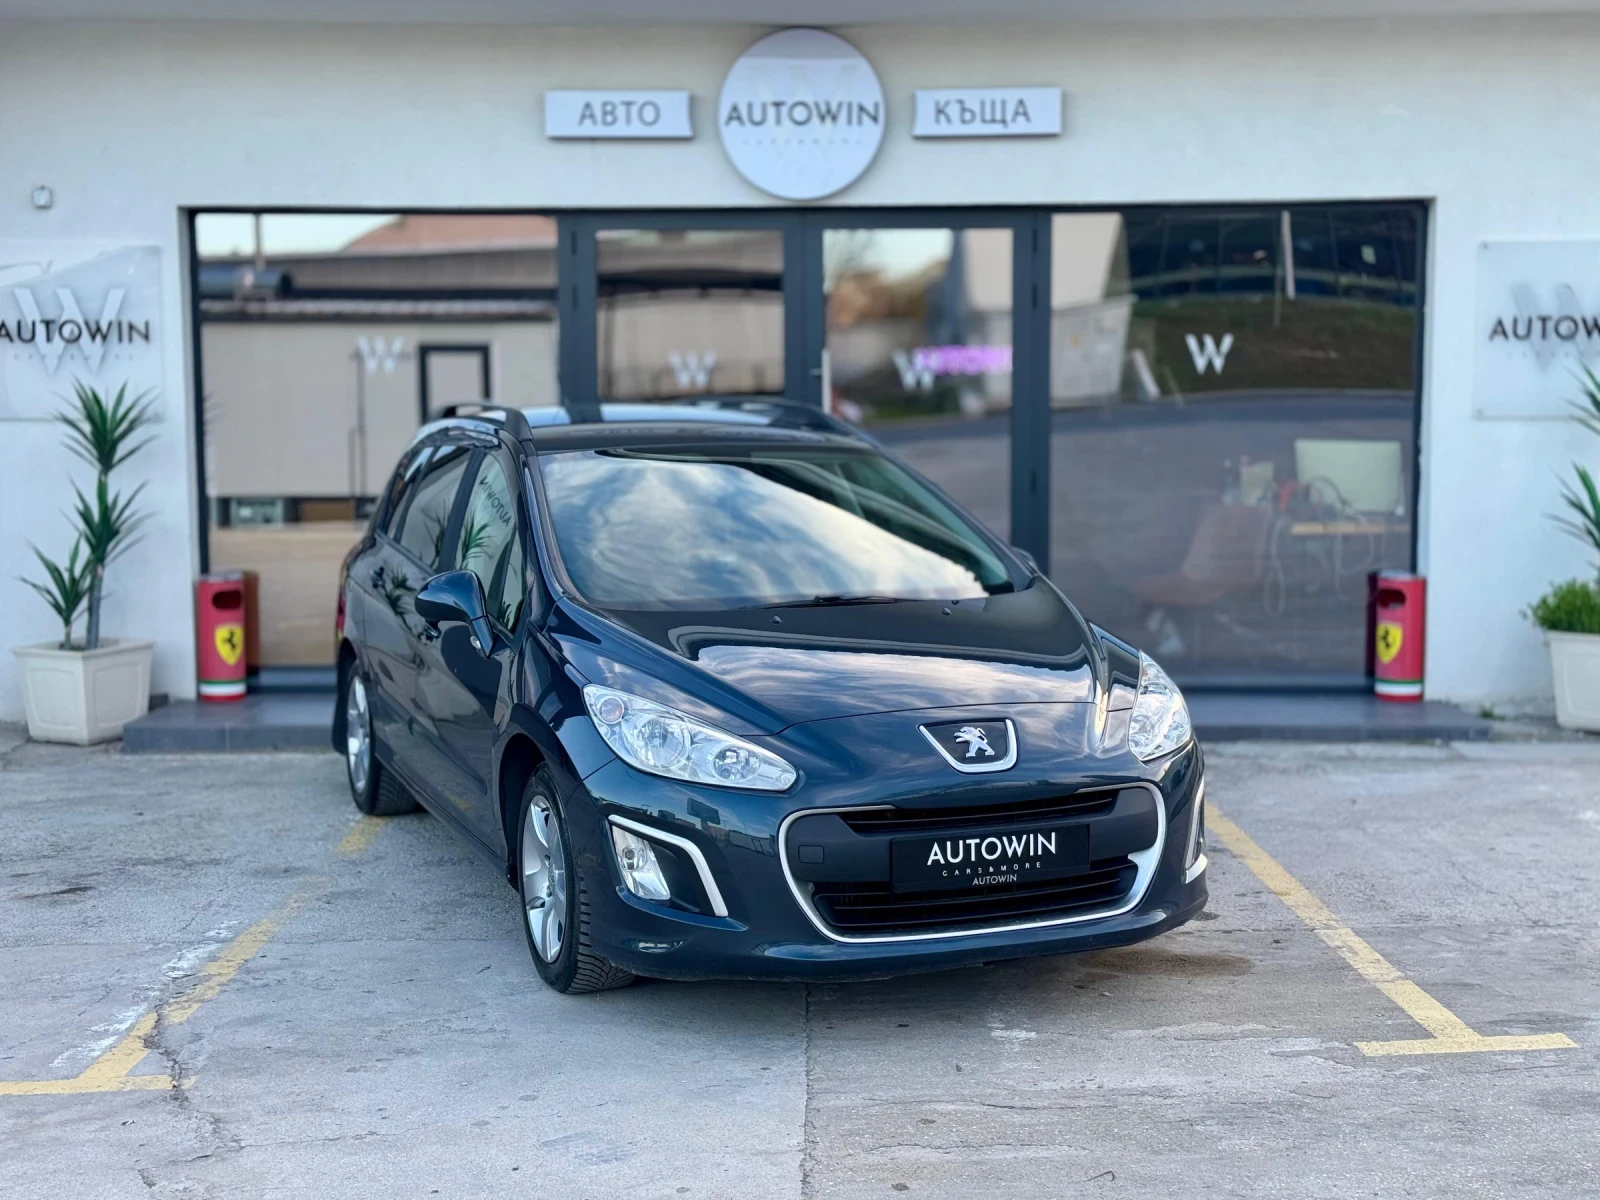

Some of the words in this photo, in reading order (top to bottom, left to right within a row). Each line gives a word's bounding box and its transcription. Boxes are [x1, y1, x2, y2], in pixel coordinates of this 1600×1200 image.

[578, 100, 662, 127] АВТО
[724, 100, 881, 127] AUTOWIN
[934, 98, 1032, 128] КЪЩА
[0, 318, 151, 344] AUTOWIN
[1185, 333, 1235, 375] W
[927, 831, 1056, 866] AUTOWIN
[972, 873, 1018, 886] AUTOWIN
